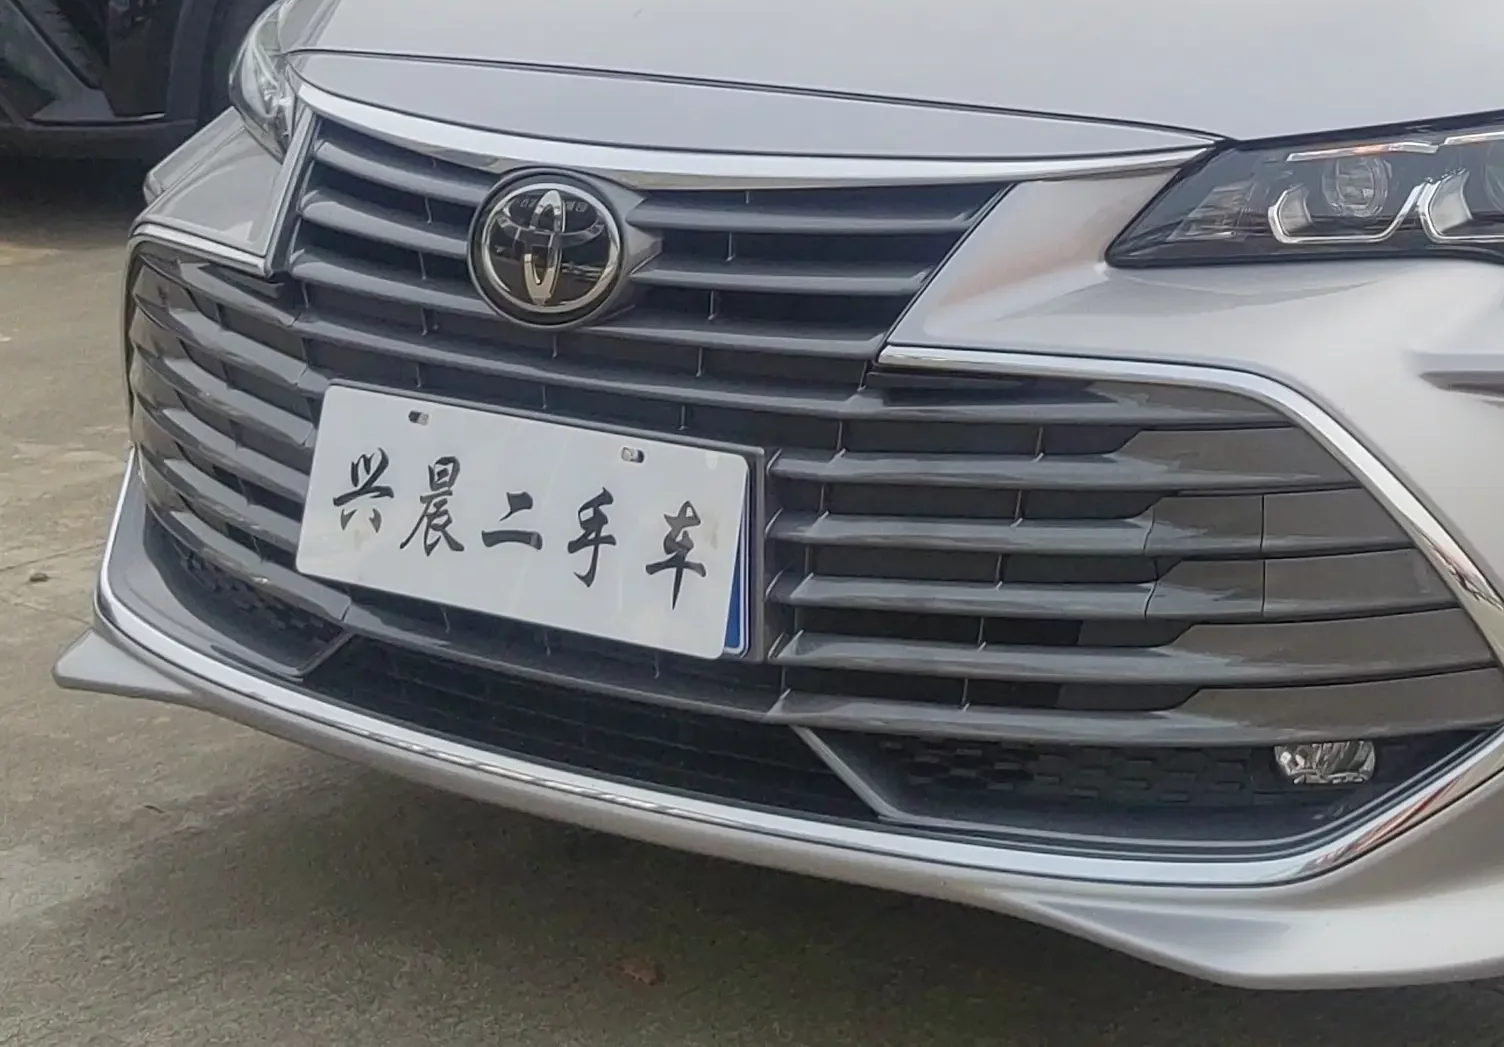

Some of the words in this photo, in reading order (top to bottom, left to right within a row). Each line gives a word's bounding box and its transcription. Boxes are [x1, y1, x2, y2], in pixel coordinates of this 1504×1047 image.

[332, 447, 707, 611] 兴晨二手车
